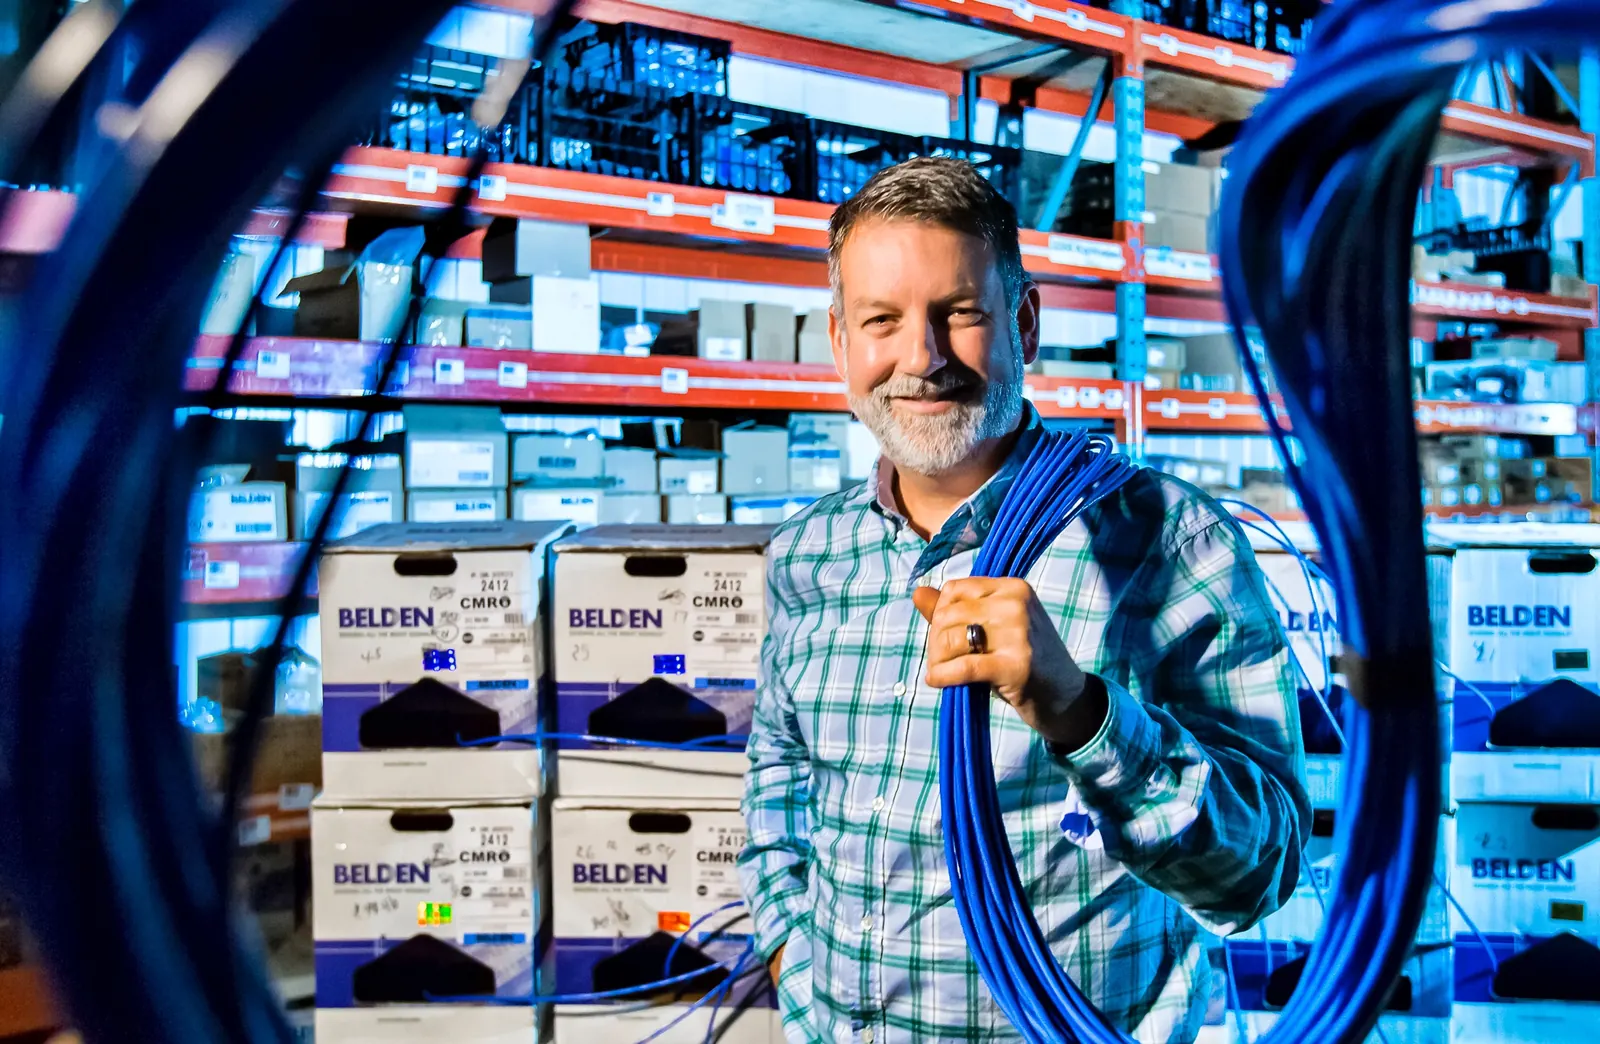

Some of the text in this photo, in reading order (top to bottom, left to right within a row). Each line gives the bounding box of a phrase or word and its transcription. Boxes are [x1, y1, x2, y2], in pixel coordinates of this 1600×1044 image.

[481, 579, 509, 592] 2412
[714, 579, 742, 592] 2412
[338, 606, 434, 628] BELDEN
[569, 608, 663, 629] BELDEN
[1468, 604, 1570, 627] BELDEN
[718, 835, 746, 848] 2412
[333, 862, 431, 884] BELDEN
[573, 863, 668, 884] BELDEN
[1472, 857, 1574, 881] BELDEN
